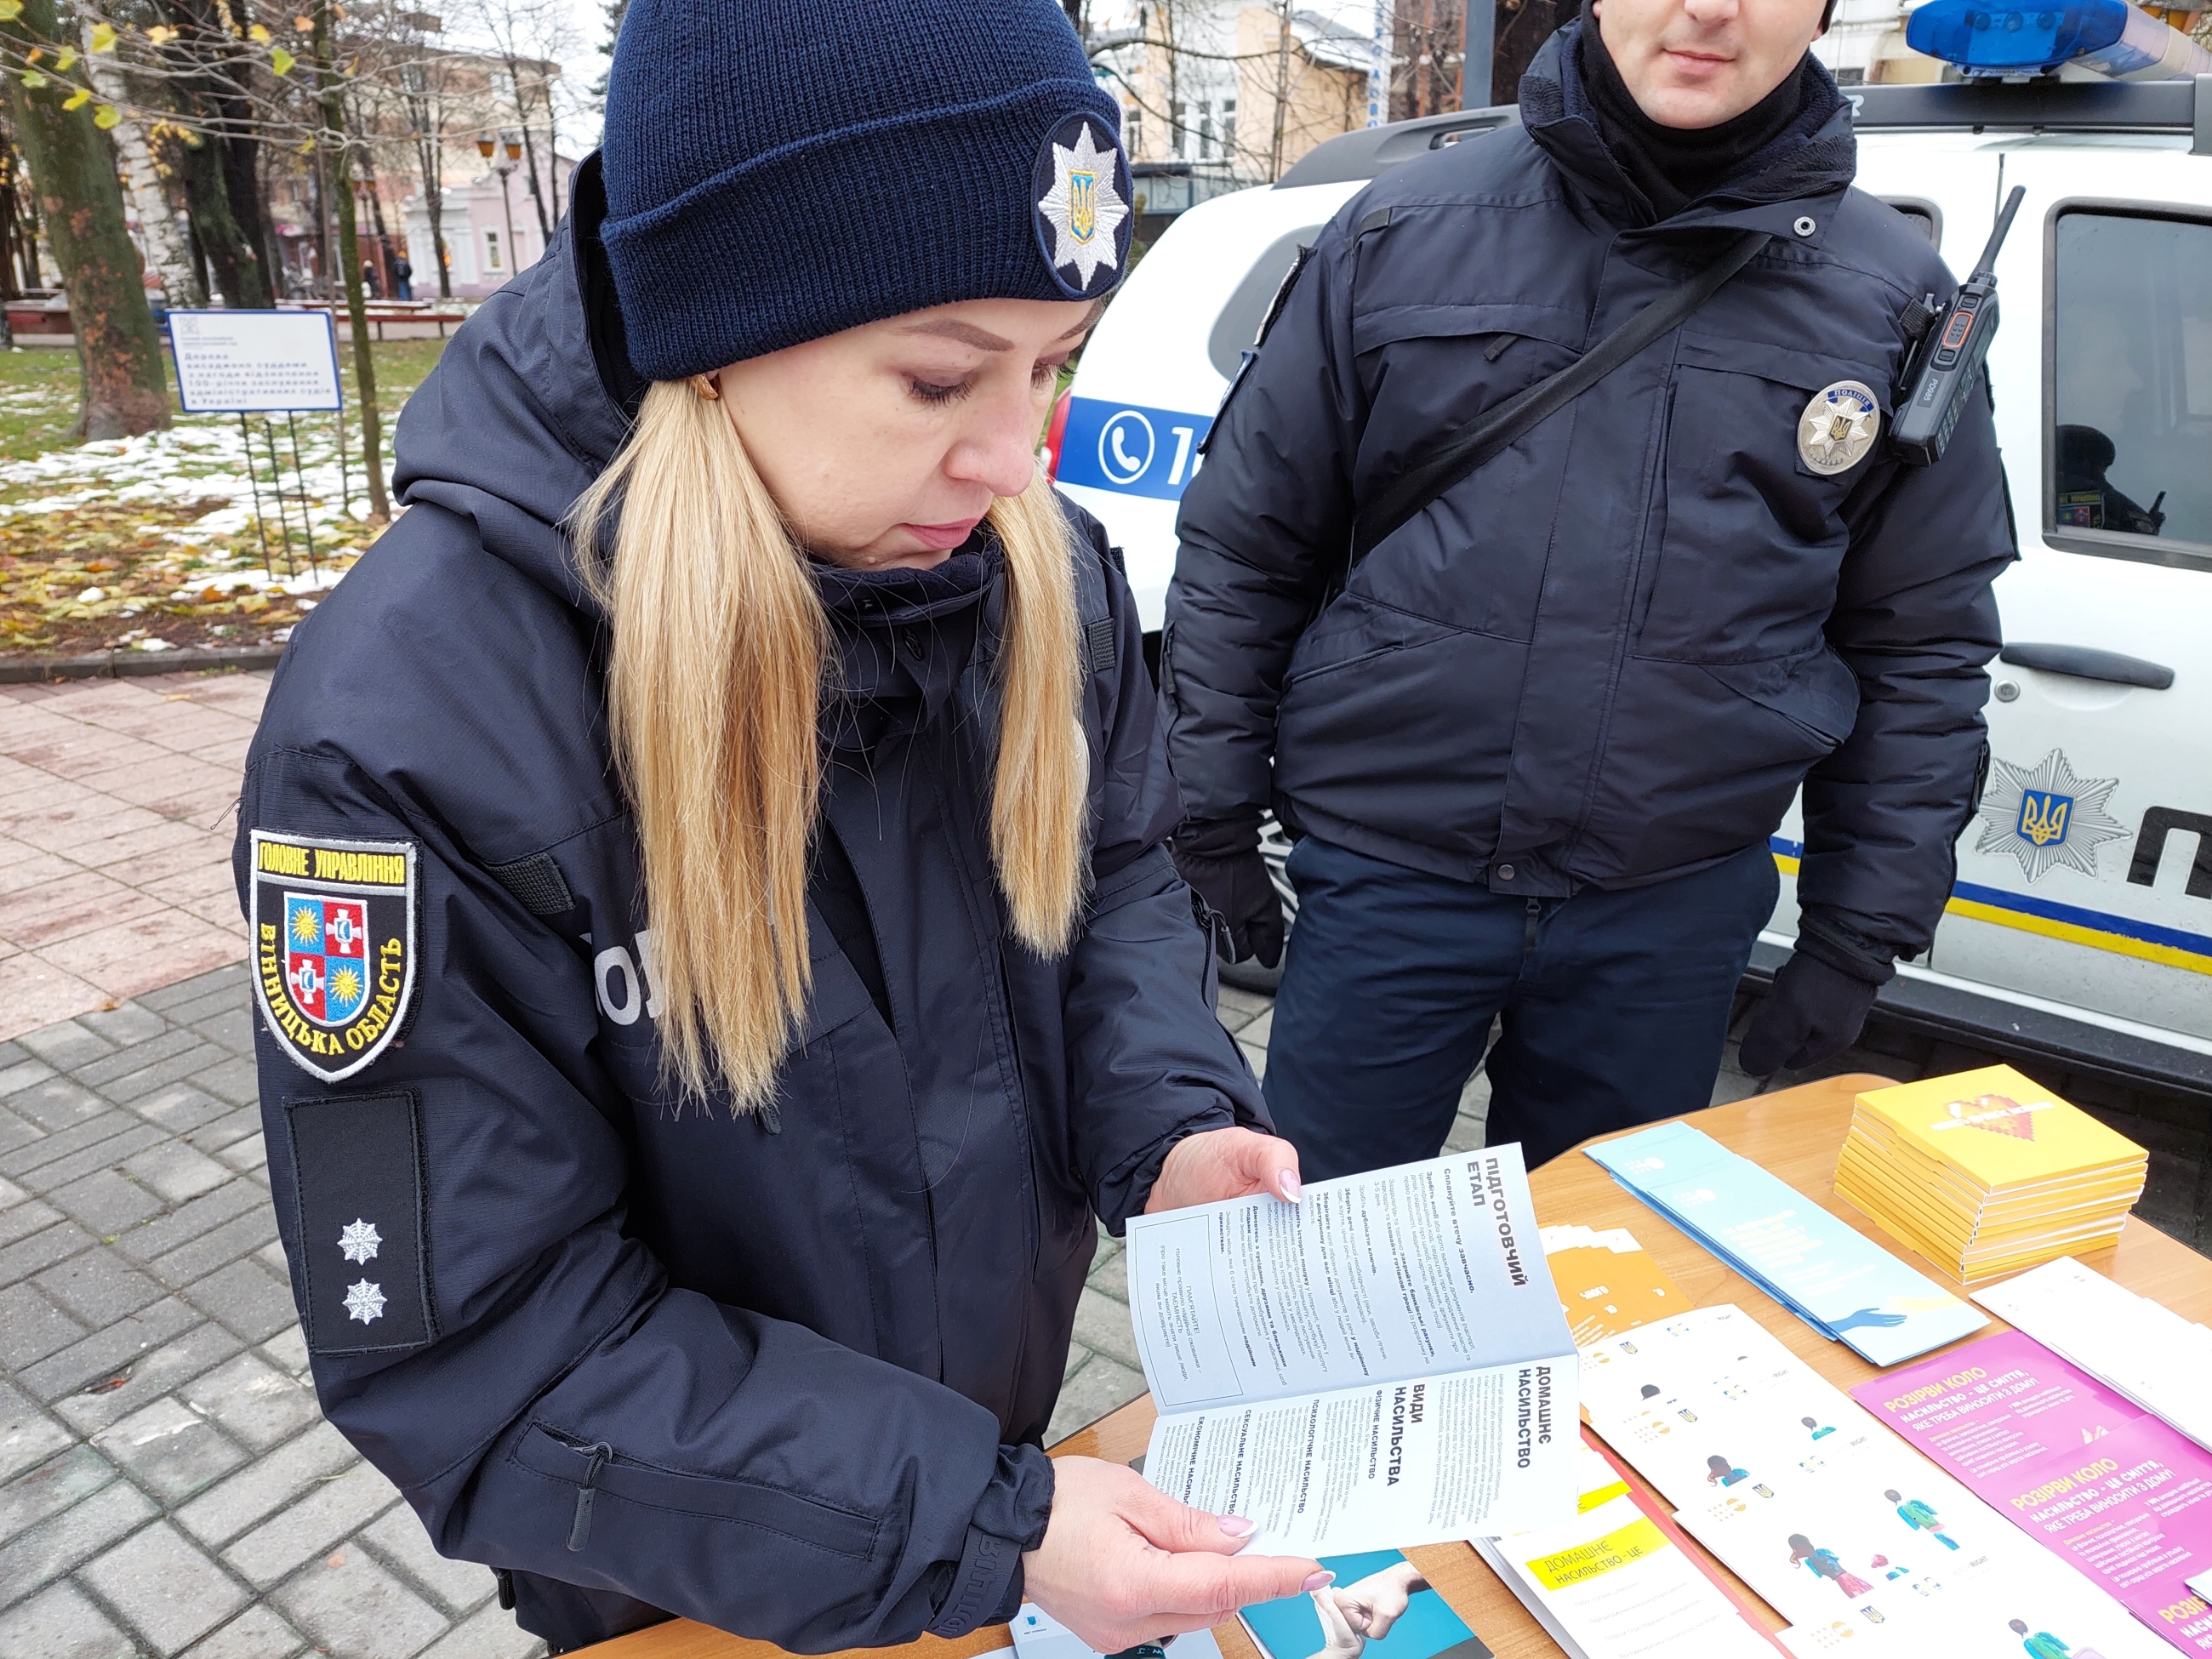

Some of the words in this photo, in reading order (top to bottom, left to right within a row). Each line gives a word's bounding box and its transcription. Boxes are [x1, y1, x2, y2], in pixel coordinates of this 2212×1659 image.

[1834, 390, 1869, 408] ПОЛІЦІЯ
[1923, 378, 1938, 402] PD985
[1167, 427, 1205, 485] 1
[259, 842, 310, 876] ГОЛОВНЕ
[315, 848, 405, 884] УПРАВЛІННЯ
[260, 923, 345, 1055] ВІННИЦЬКА
[345, 938, 402, 1050] ОБЛАСТЬ
[1466, 1161, 1486, 1206] ЕТАП
[1484, 1157, 1529, 1286] ПІДГОТОВЧИЙ
[1373, 1389, 1382, 1422] ФІЗИЧНЕ
[1409, 1383, 1425, 1424] ВИДИ
[1536, 1365, 1553, 1445] ДОМАШНЄ
[1881, 1382, 1949, 1413] РОЗІРВИ
[1940, 1366, 1993, 1390] КОЛО
[1898, 1393, 1970, 1423] НАСИЛЬСТВО
[1971, 1383, 1992, 1395] ЦЕ
[1986, 1368, 2032, 1388] СМІТТЯ,
[1910, 1419, 1934, 1432] ЯКЕ
[1928, 1408, 1962, 1425] ТРЕБА
[1955, 1391, 2007, 1414] ВИНОСИТИ
[2007, 1377, 2041, 1394] ДОМУ!
[1189, 1417, 1205, 1465] ЕКОНОМІЧНЕ
[1237, 1409, 1251, 1458] СЕКСУАЛЬНЕ
[1305, 1400, 1320, 1458] ПСИХОЛОГІЧНЕ
[1386, 1386, 1407, 1486] НАСИЛЬСТВА
[1517, 1368, 1532, 1469] НАСИЛЬСТВО
[1368, 1424, 1379, 1479] НАСИЛЬСТВО
[1183, 1468, 1194, 1505] НАСИЛЬС
[1228, 1461, 1243, 1515] НАСИЛЬСТВО
[1297, 1460, 1311, 1514] НАСИЛЬСТВО
[2009, 1476, 2080, 1512] РОЗІРВИ
[2070, 1457, 2122, 1485] КОЛО
[2028, 1487, 2102, 1524] НАСИЛЬСТВО
[2103, 1477, 2124, 1491] ЦЕ
[2118, 1458, 2166, 1483] СМІТТЯ,
[2043, 1519, 2068, 1535] ЯКЕ
[2061, 1507, 2095, 1526] ТРЕБА
[2088, 1485, 2143, 1514] ВИНОСИТИ
[2141, 1468, 2178, 1490] ДОМУ!
[1542, 1540, 1615, 1574] ДОМАШНЄ
[1554, 1554, 1624, 1584] НАСИЛЬСТВО
[1626, 1546, 1644, 1559] ЦЕ
[2158, 1595, 2209, 1625] РОЗІР
